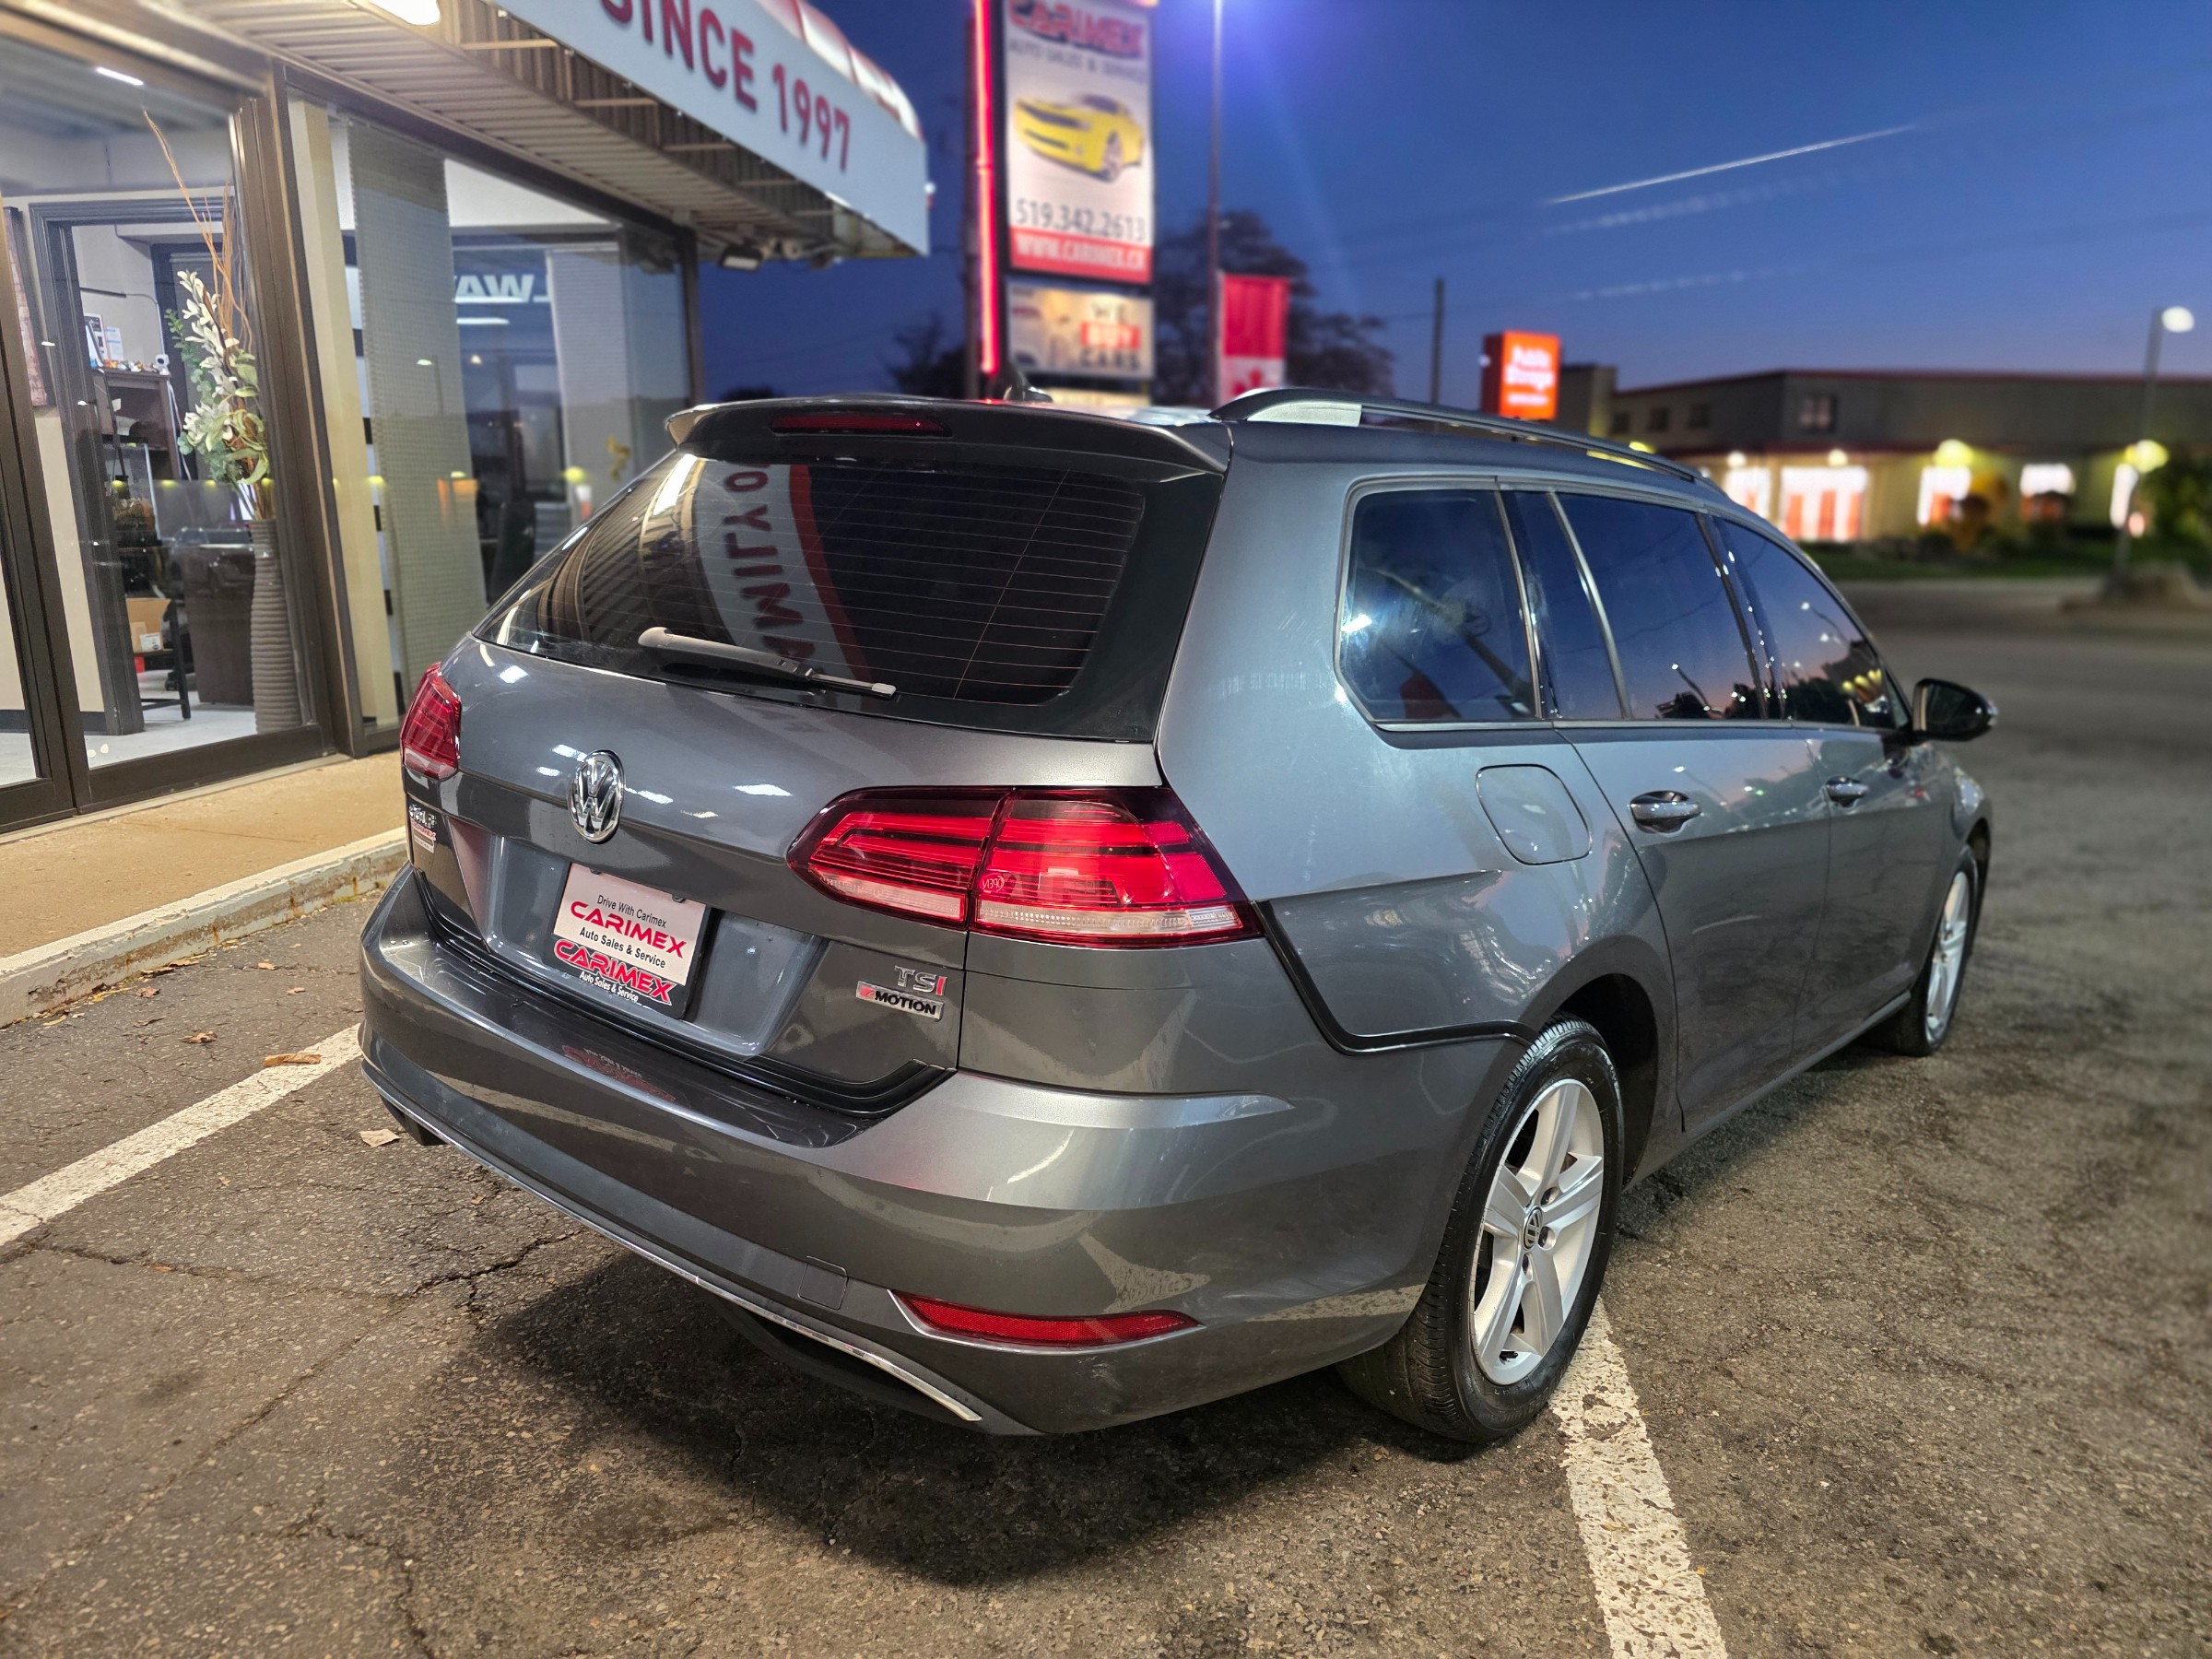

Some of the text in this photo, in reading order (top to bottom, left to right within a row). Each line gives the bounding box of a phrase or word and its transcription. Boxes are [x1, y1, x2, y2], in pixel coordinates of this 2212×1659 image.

[771, 63, 850, 172] 1997
[1016, 196, 1147, 243] 519.342.2613
[570, 900, 688, 959] CARIMEX
[597, 894, 667, 929] Drive With Carimex
[579, 926, 666, 969] Auto Sales & Service
[555, 939, 676, 1006] CARIMEX
[579, 971, 639, 1004] Auto Sales & Service
[894, 965, 947, 996] TSI
